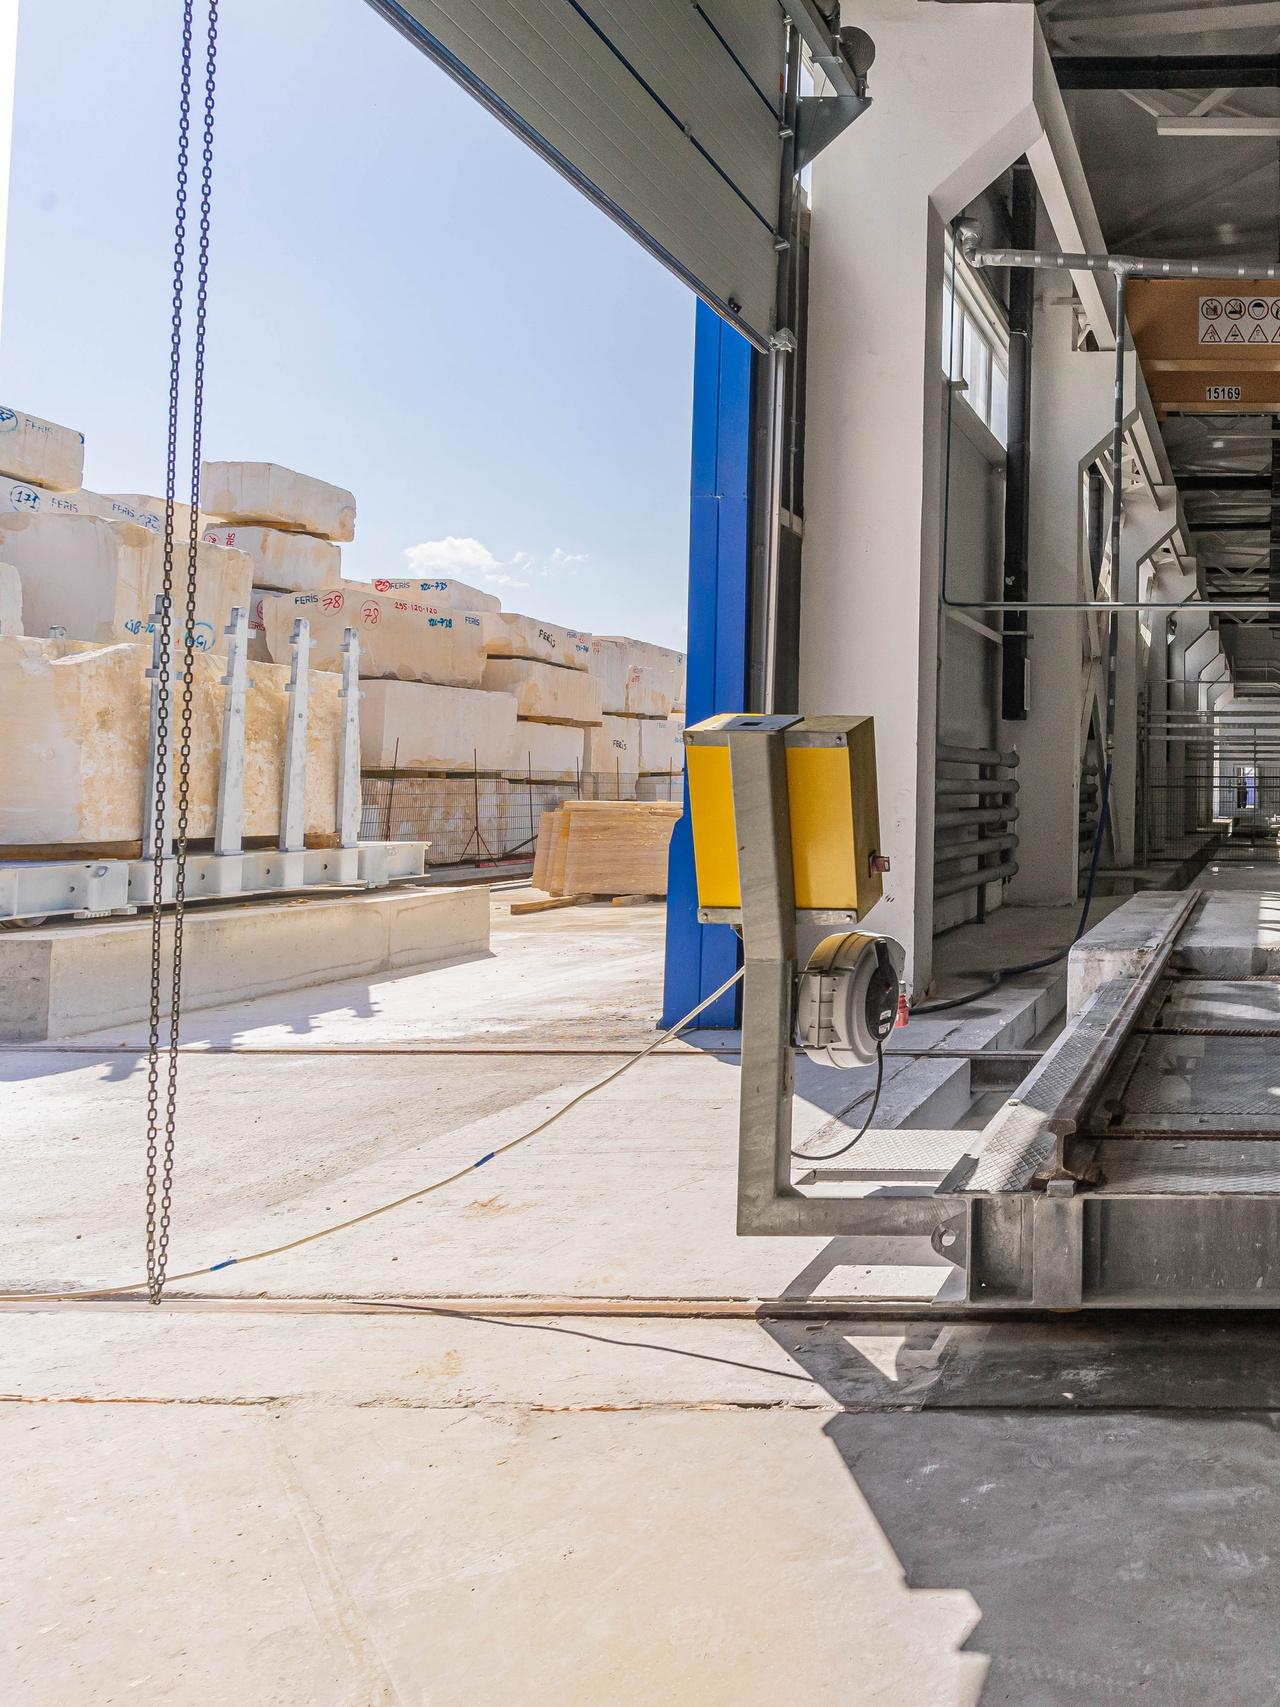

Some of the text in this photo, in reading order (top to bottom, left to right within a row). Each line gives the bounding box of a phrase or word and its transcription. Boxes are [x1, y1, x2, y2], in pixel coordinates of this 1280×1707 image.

[1207, 387, 1241, 400] 15169
[322, 595, 342, 611] 78
[363, 608, 380, 625] 78
